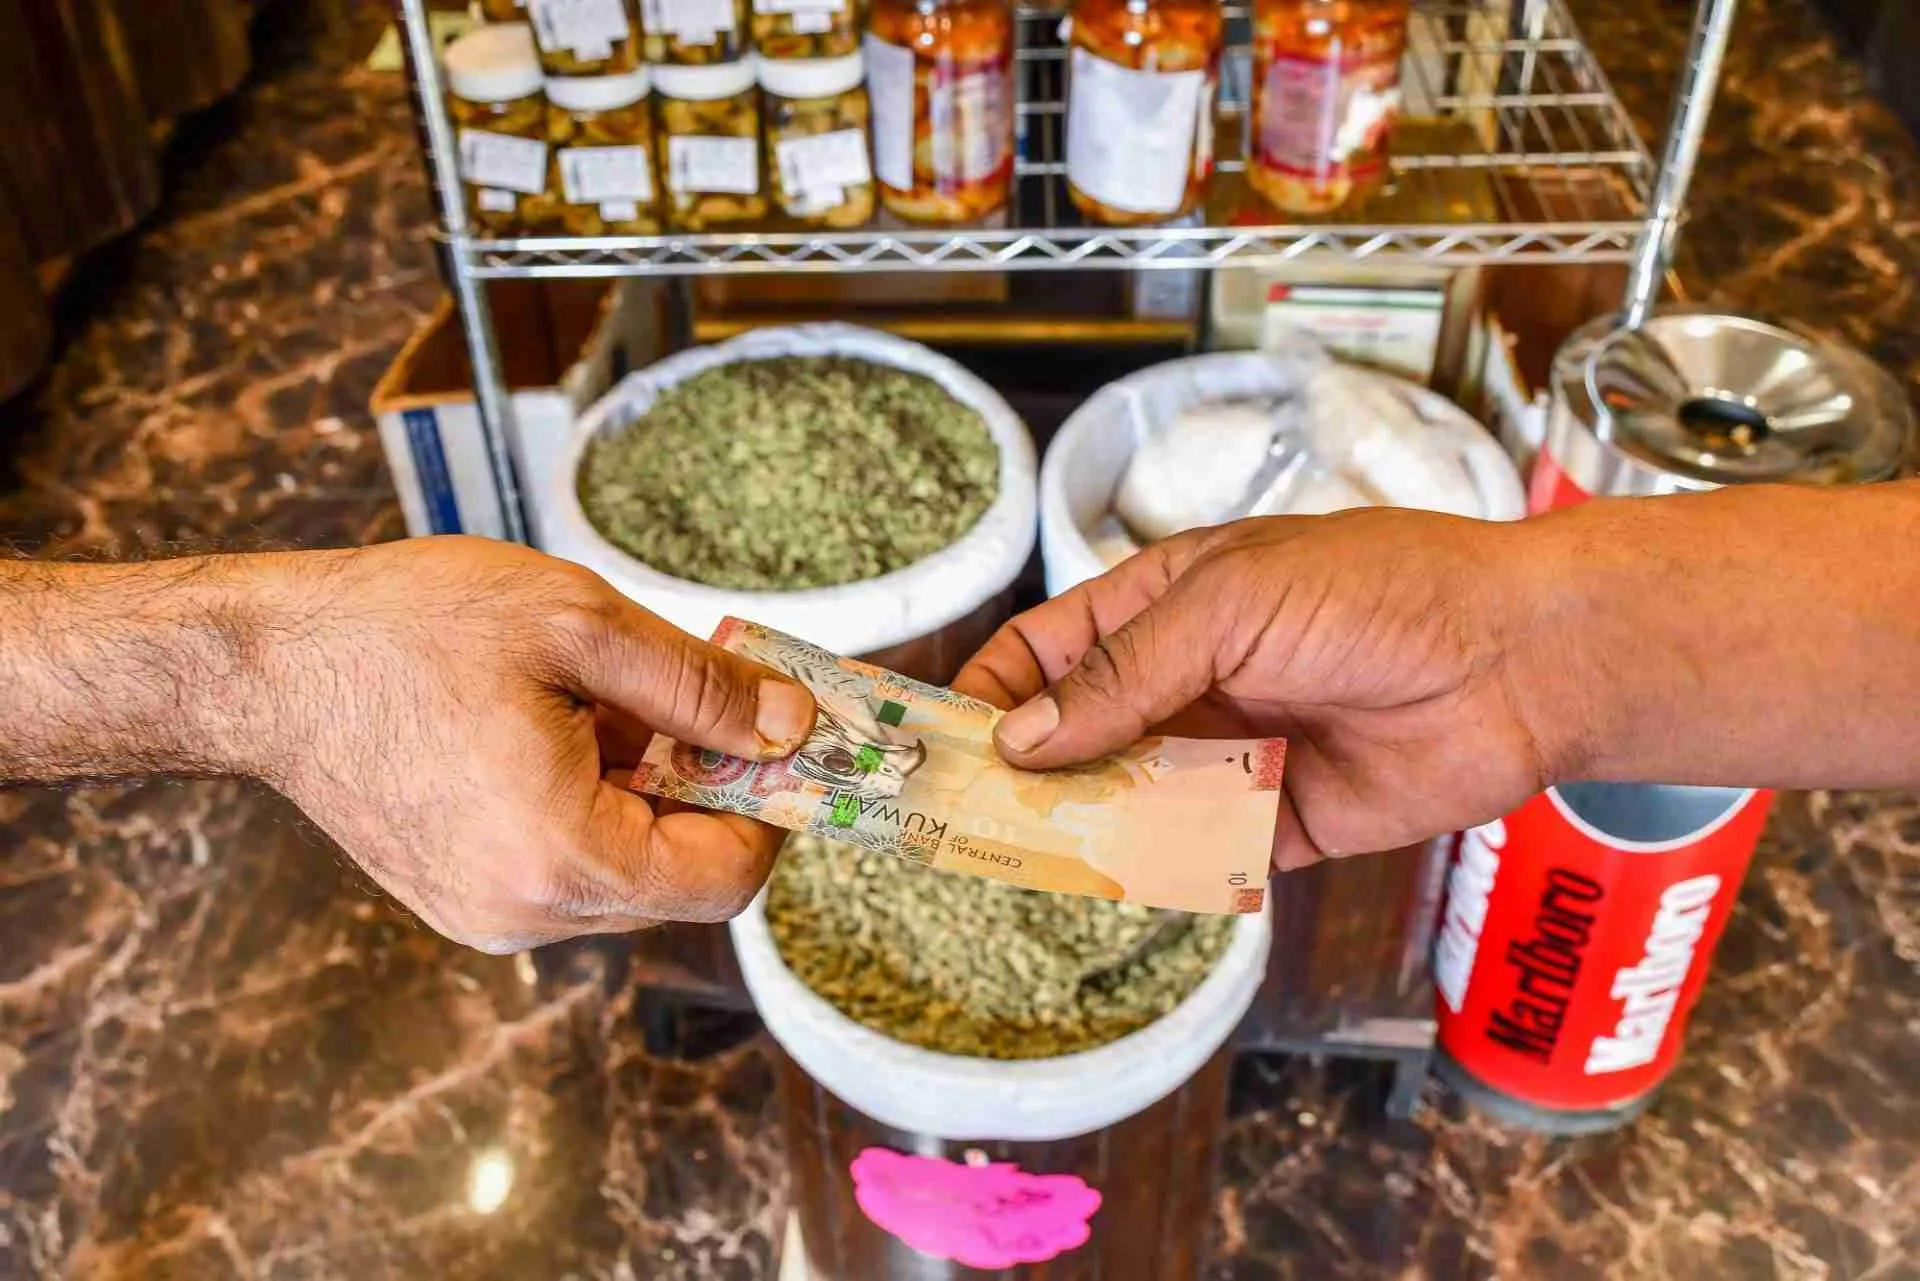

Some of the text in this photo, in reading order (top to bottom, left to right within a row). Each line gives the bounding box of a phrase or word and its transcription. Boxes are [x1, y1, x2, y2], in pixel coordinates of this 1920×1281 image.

[821, 790, 969, 846] OF KUWAIT
[898, 831, 1022, 869] CENTRAL BANK
[1228, 871, 1248, 886] 10
[1486, 868, 1604, 1065] Marlboro
